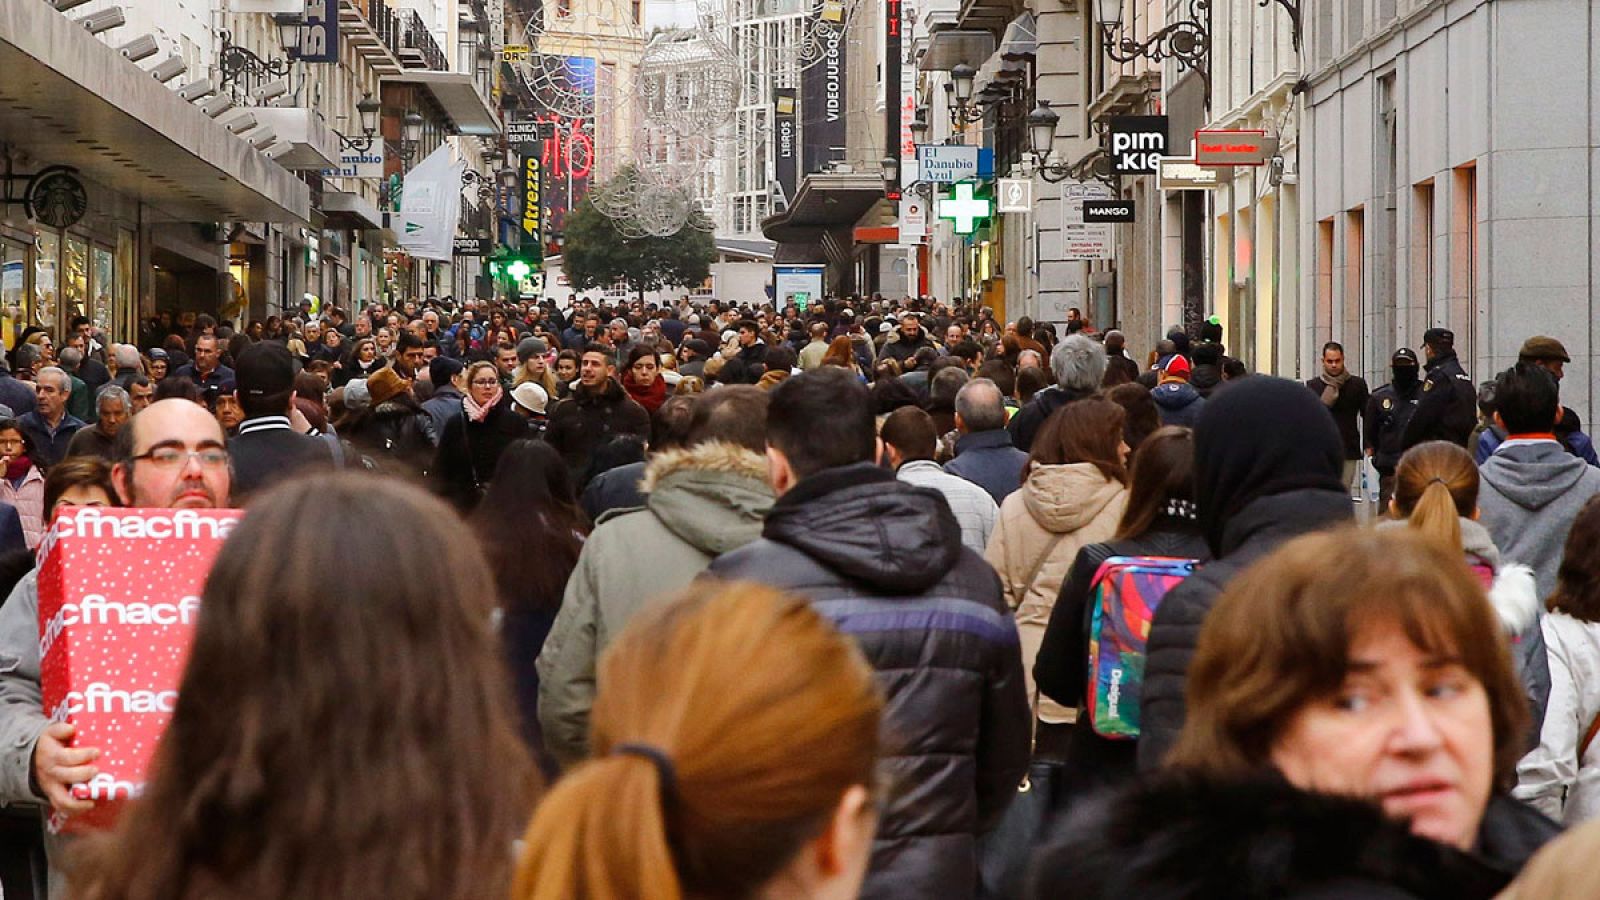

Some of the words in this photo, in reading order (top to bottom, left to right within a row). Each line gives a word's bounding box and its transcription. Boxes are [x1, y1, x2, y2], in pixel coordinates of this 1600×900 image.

[827, 31, 839, 122] VIDEOJUEGOS
[508, 134, 535, 142] DENTAL
[781, 121, 792, 157] LIBROS
[1113, 132, 1164, 155] pim
[924, 148, 937, 157] El
[341, 153, 382, 163] nubio
[924, 158, 973, 168] Danubio
[925, 170, 953, 180] Azul
[523, 158, 539, 241] Atrezzo
[1089, 207, 1129, 216] MANGO
